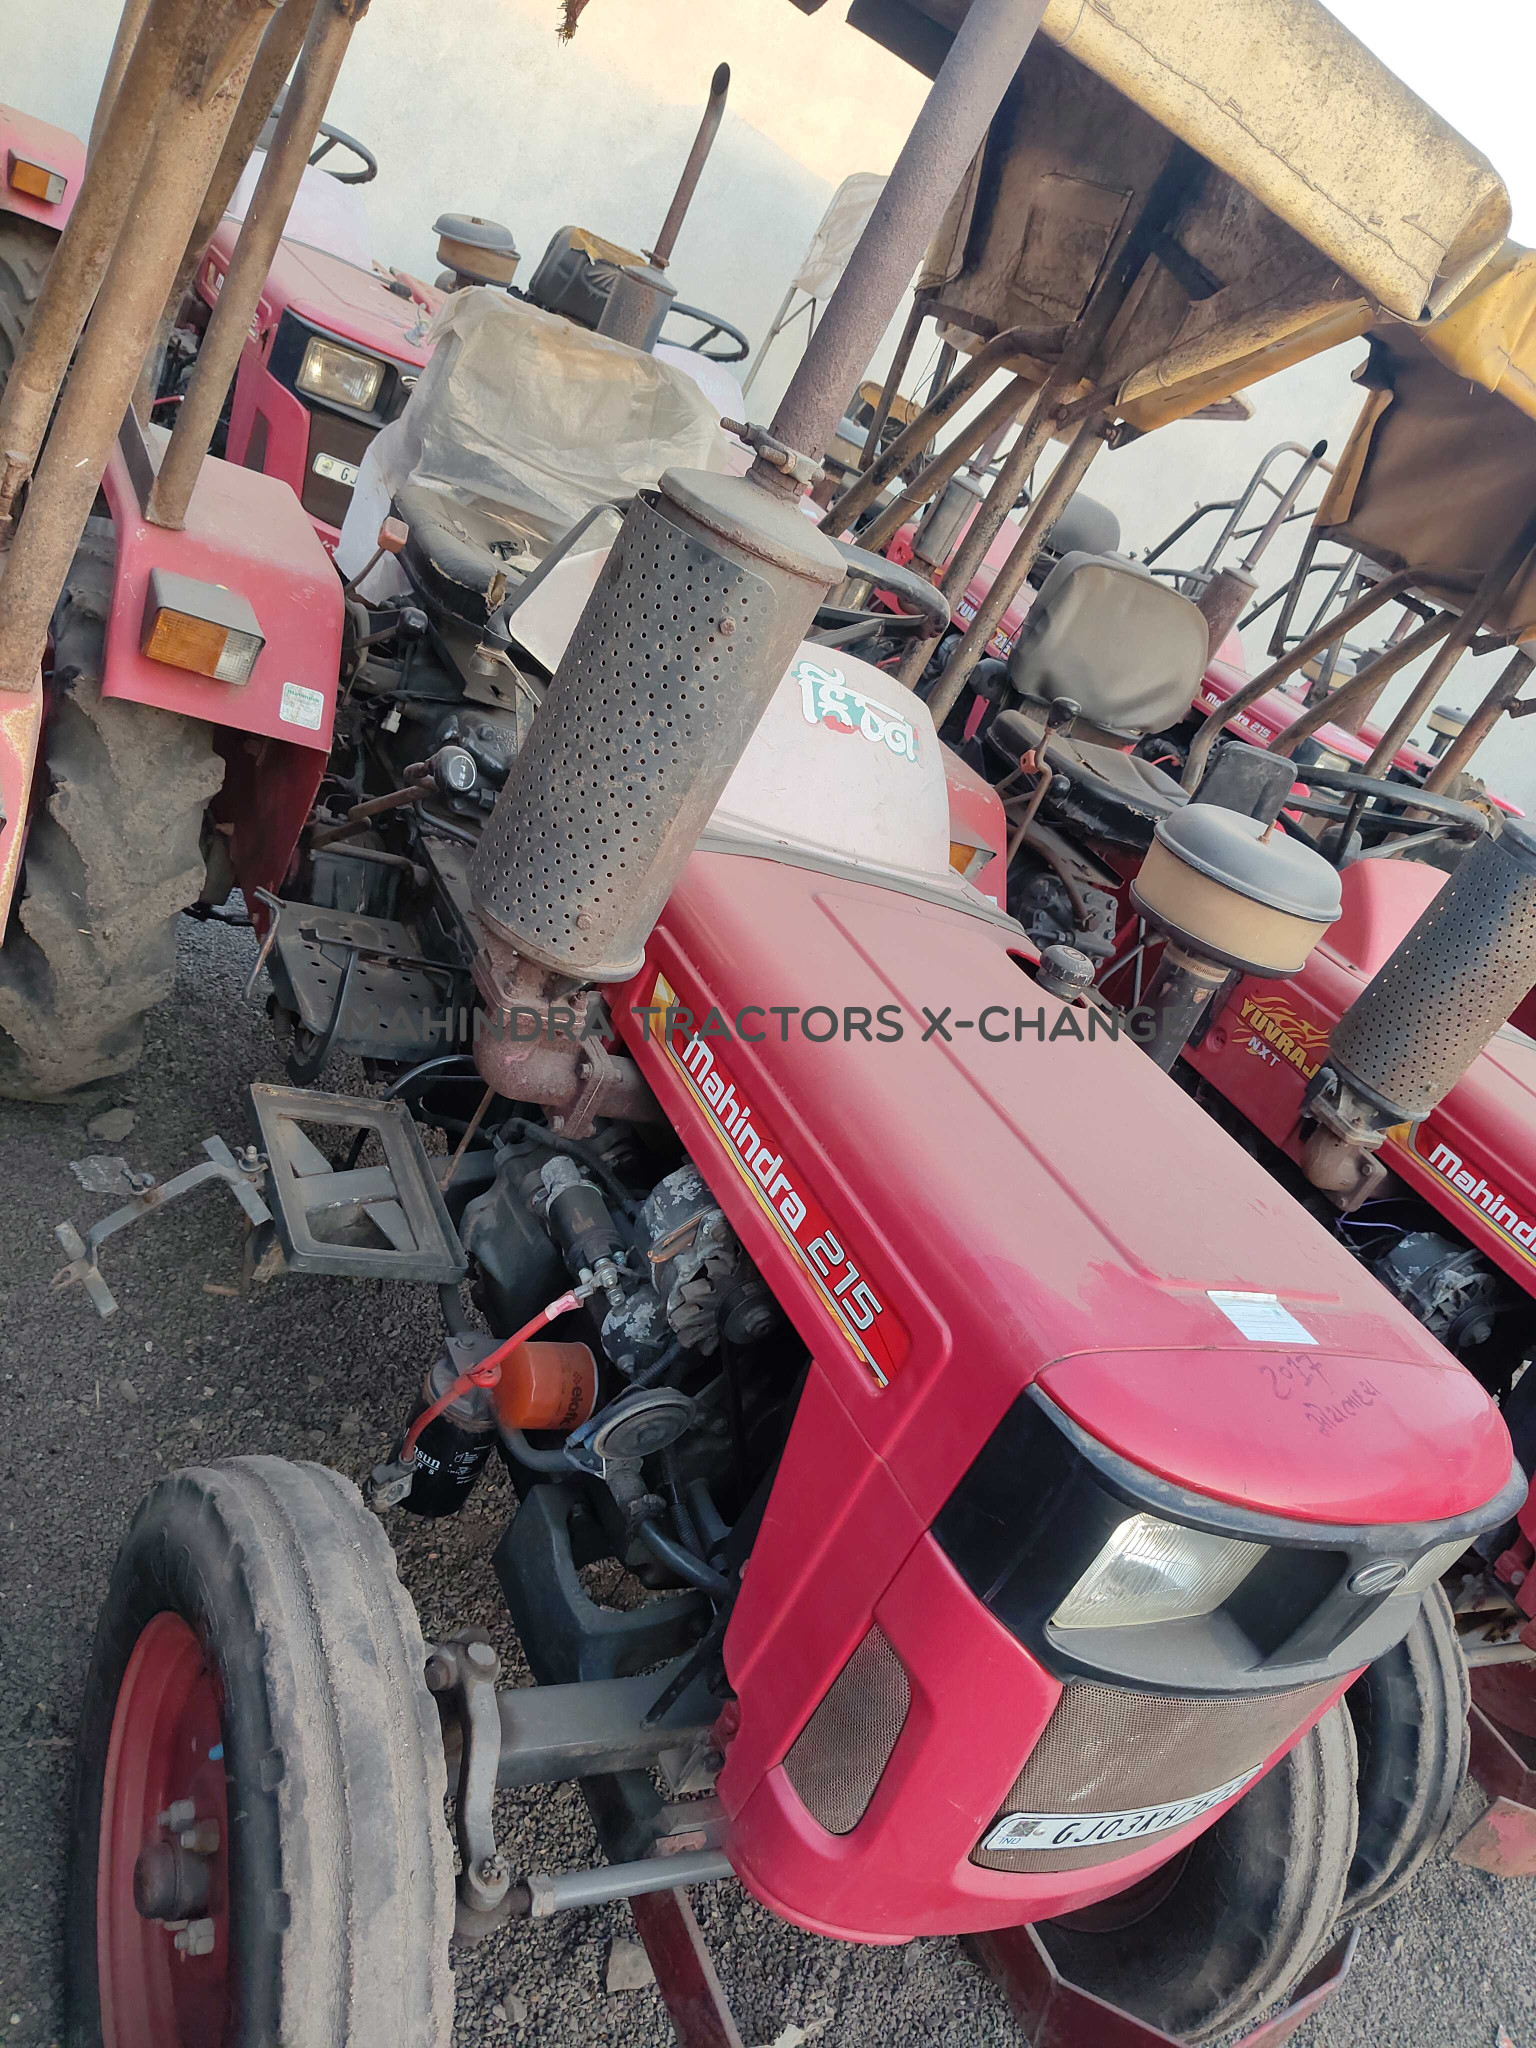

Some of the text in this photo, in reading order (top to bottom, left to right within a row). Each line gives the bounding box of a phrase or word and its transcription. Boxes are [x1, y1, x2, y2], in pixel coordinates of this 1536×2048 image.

[1249, 721, 1272, 740] 215
[1239, 998, 1320, 1080] YUVRAJ
[1247, 1035, 1281, 1067] NXT
[682, 1030, 883, 1331] Mahindra 215
[1428, 1143, 1536, 1255] Mahind
